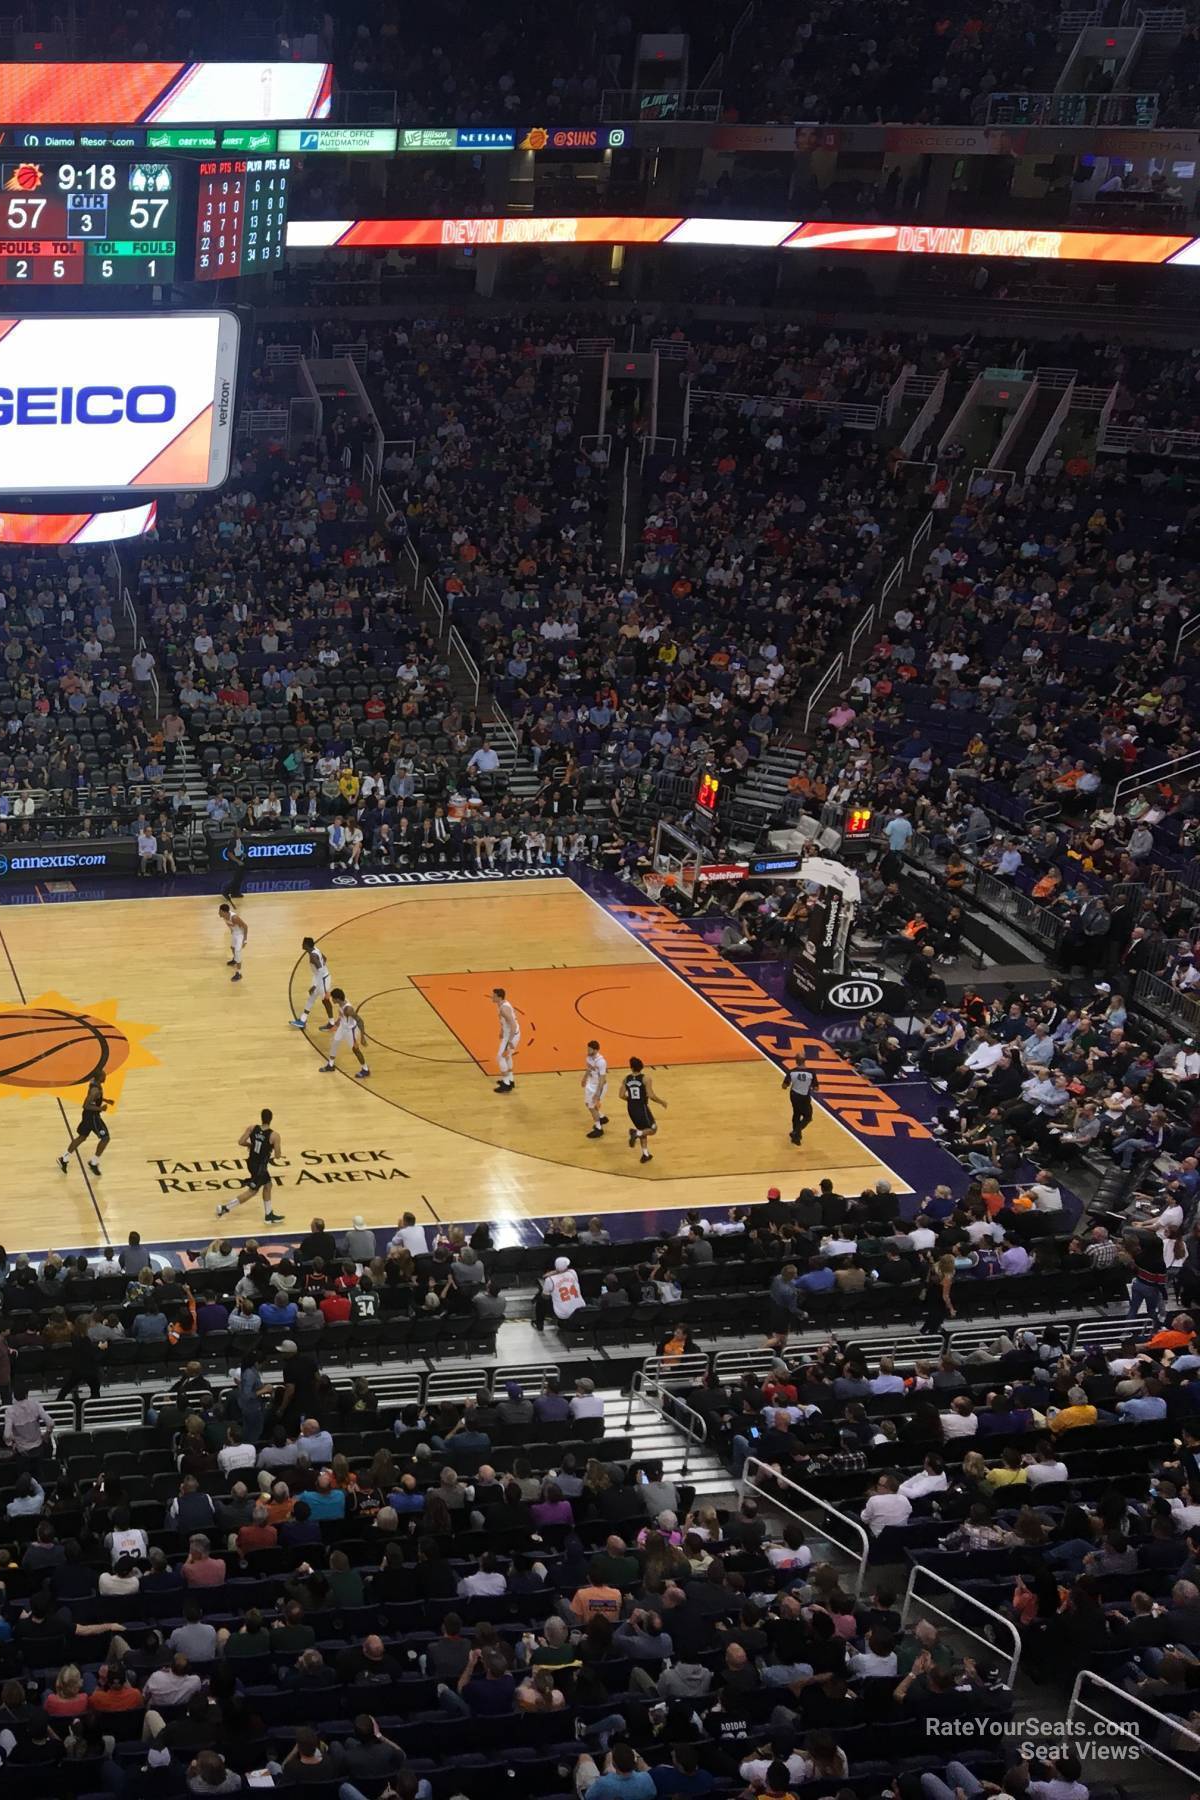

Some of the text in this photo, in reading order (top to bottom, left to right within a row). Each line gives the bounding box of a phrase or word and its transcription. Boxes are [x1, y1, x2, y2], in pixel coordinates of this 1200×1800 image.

[320, 131, 347, 139] PACIFIC
[421, 138, 452, 146] Electric
[553, 131, 597, 146] @SUNS
[200, 161, 246, 175] PLYR PTS FLS
[247, 158, 290, 172] PLYR PTS FLS
[58, 164, 116, 190] 9:18
[255, 178, 285, 192] 6 4 0
[208, 181, 240, 195] 1 9 2
[71, 195, 104, 208] QTR
[206, 200, 239, 215] 3 11 0
[251, 196, 284, 211] 11 8 0
[7, 198, 47, 229] 57
[129, 198, 169, 229] 57
[250, 213, 283, 228] 13 5 0
[81, 214, 93, 232] 3
[203, 217, 237, 233] 16 7 1
[442, 218, 577, 244] DEVIN BOOKER
[0, 242, 77, 254] FOULS TOL
[95, 242, 174, 254] TOL FOULS
[898, 226, 1060, 258] DEVIN BOOKER
[218, 251, 236, 265] 0 3
[16, 260, 65, 278] 2 5
[102, 260, 156, 278] 5 1
[218, 381, 231, 428] verizon
[248, 843, 313, 858] annexus
[361, 866, 564, 884] annexus.com
[823, 900, 840, 947] Southwest
[838, 987, 874, 1003] KIA
[608, 904, 934, 1139] PHOENIX SUNS
[147, 1149, 395, 1175] TALKIG STICK
[155, 1168, 412, 1194] RESOT ARENA
[558, 1286, 579, 1302] 24
[357, 1301, 376, 1317] 34
[720, 1720, 747, 1732] ADIDAS
